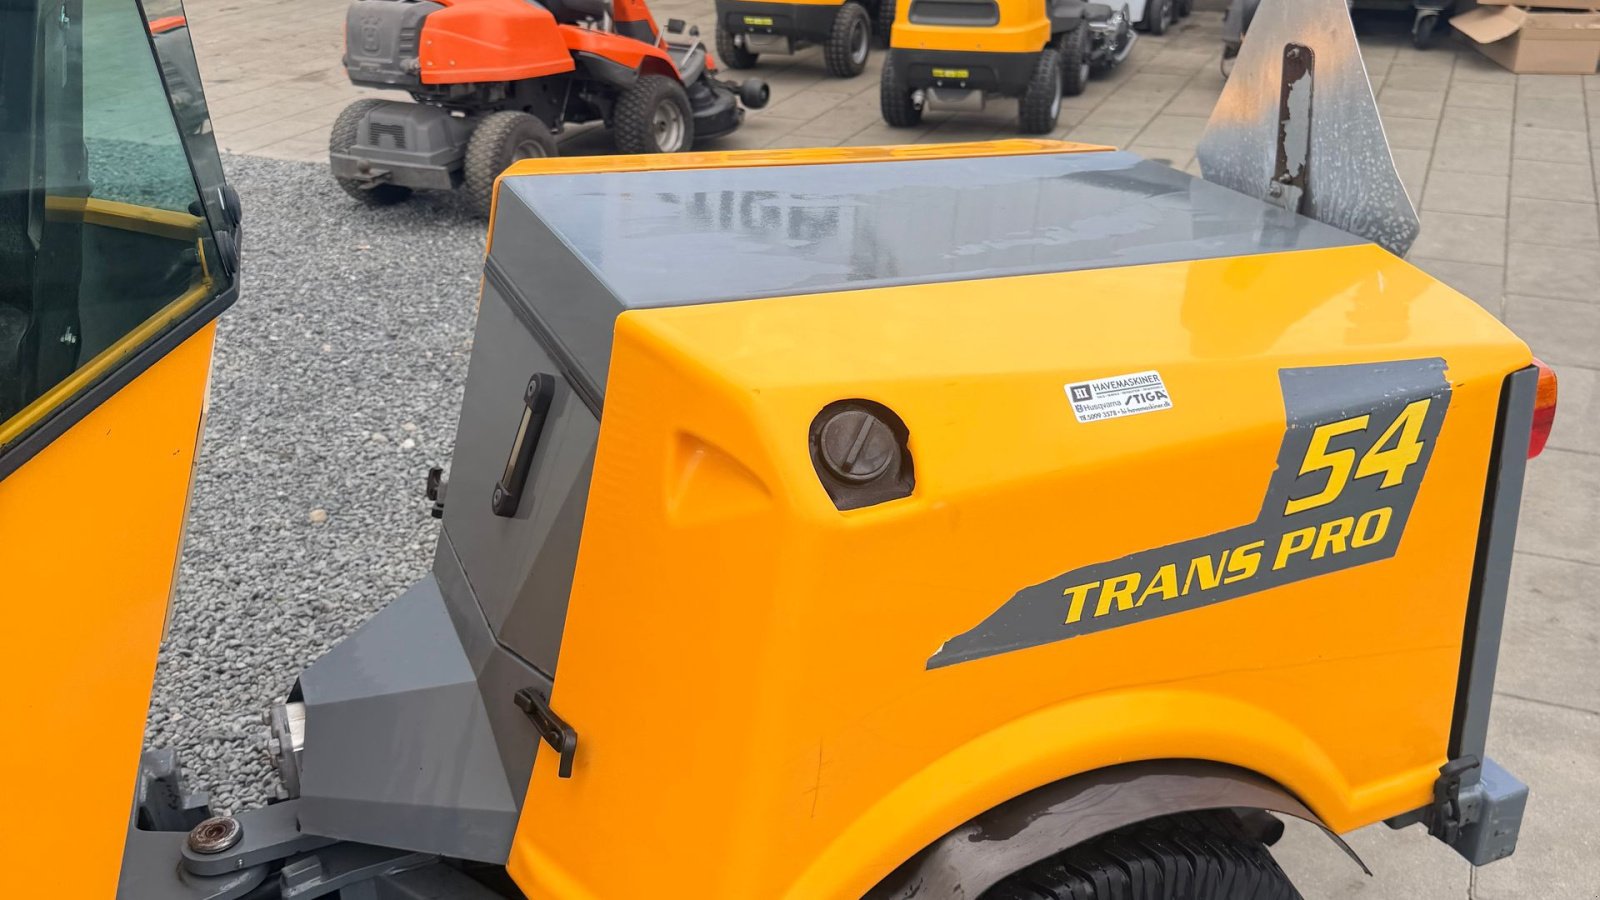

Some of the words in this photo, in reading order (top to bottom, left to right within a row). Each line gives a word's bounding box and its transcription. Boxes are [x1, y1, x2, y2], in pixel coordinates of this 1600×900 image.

[1092, 374, 1161, 392] HAVEMASKINER
[1083, 400, 1122, 412] Husqvarna
[1125, 391, 1168, 406] STIGA
[1284, 398, 1432, 516] 54
[1063, 540, 1265, 625] TRANS
[1271, 506, 1393, 571] PRO
